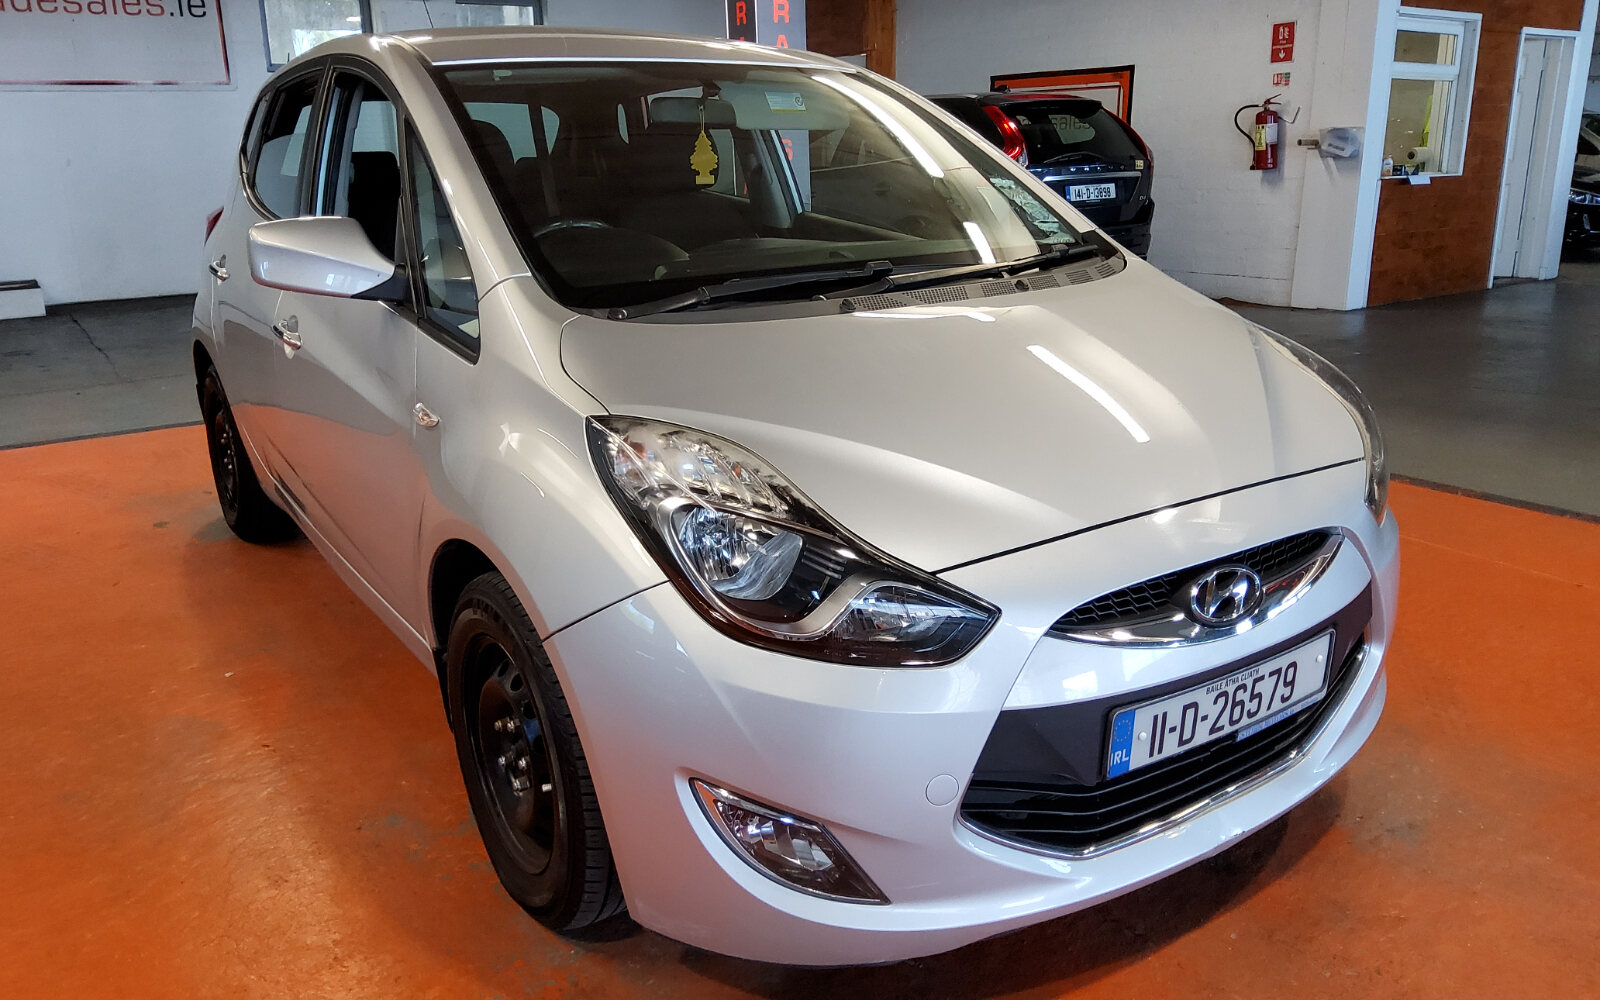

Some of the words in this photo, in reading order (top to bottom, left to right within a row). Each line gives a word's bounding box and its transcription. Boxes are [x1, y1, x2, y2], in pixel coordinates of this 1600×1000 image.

[0, 0, 207, 18] desales.ie
[1205, 682, 1224, 695] BAILE
[1149, 661, 1298, 758] 11-D-26579
[1110, 749, 1129, 766] IRL
